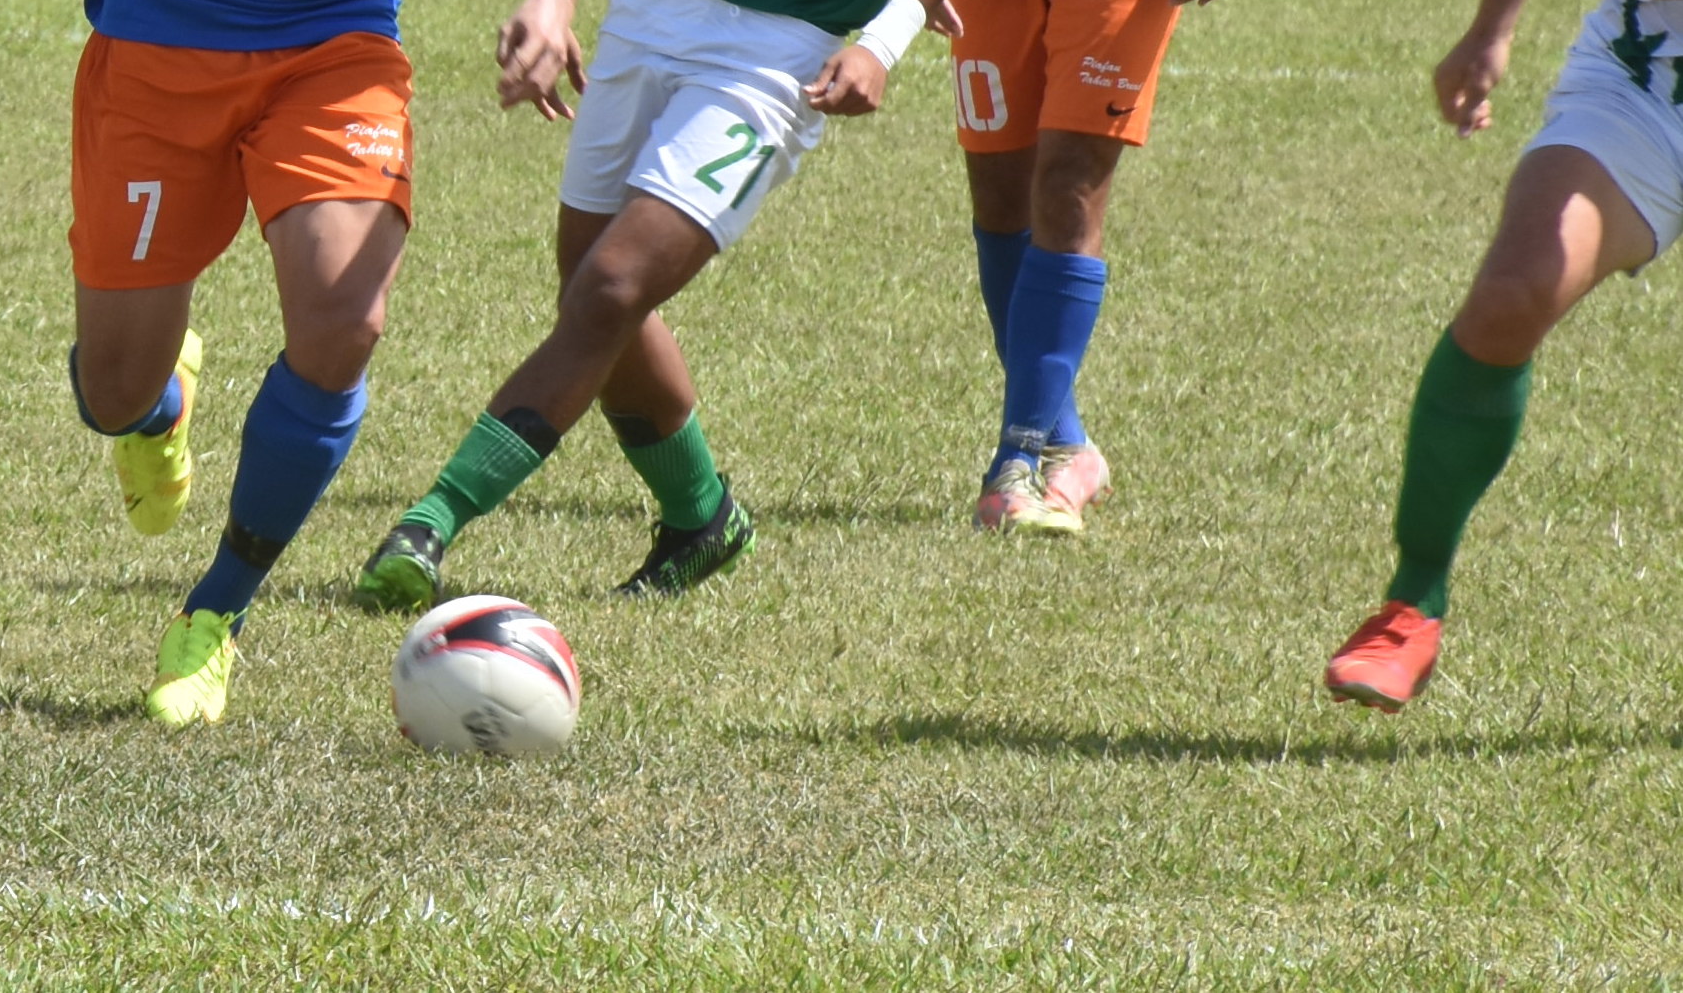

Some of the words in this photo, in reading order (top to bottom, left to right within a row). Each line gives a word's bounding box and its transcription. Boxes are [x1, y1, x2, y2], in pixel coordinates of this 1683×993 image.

[952, 55, 1009, 132] 10
[346, 142, 394, 157] Tahiti
[693, 122, 777, 211] 21
[127, 180, 162, 261] 7
